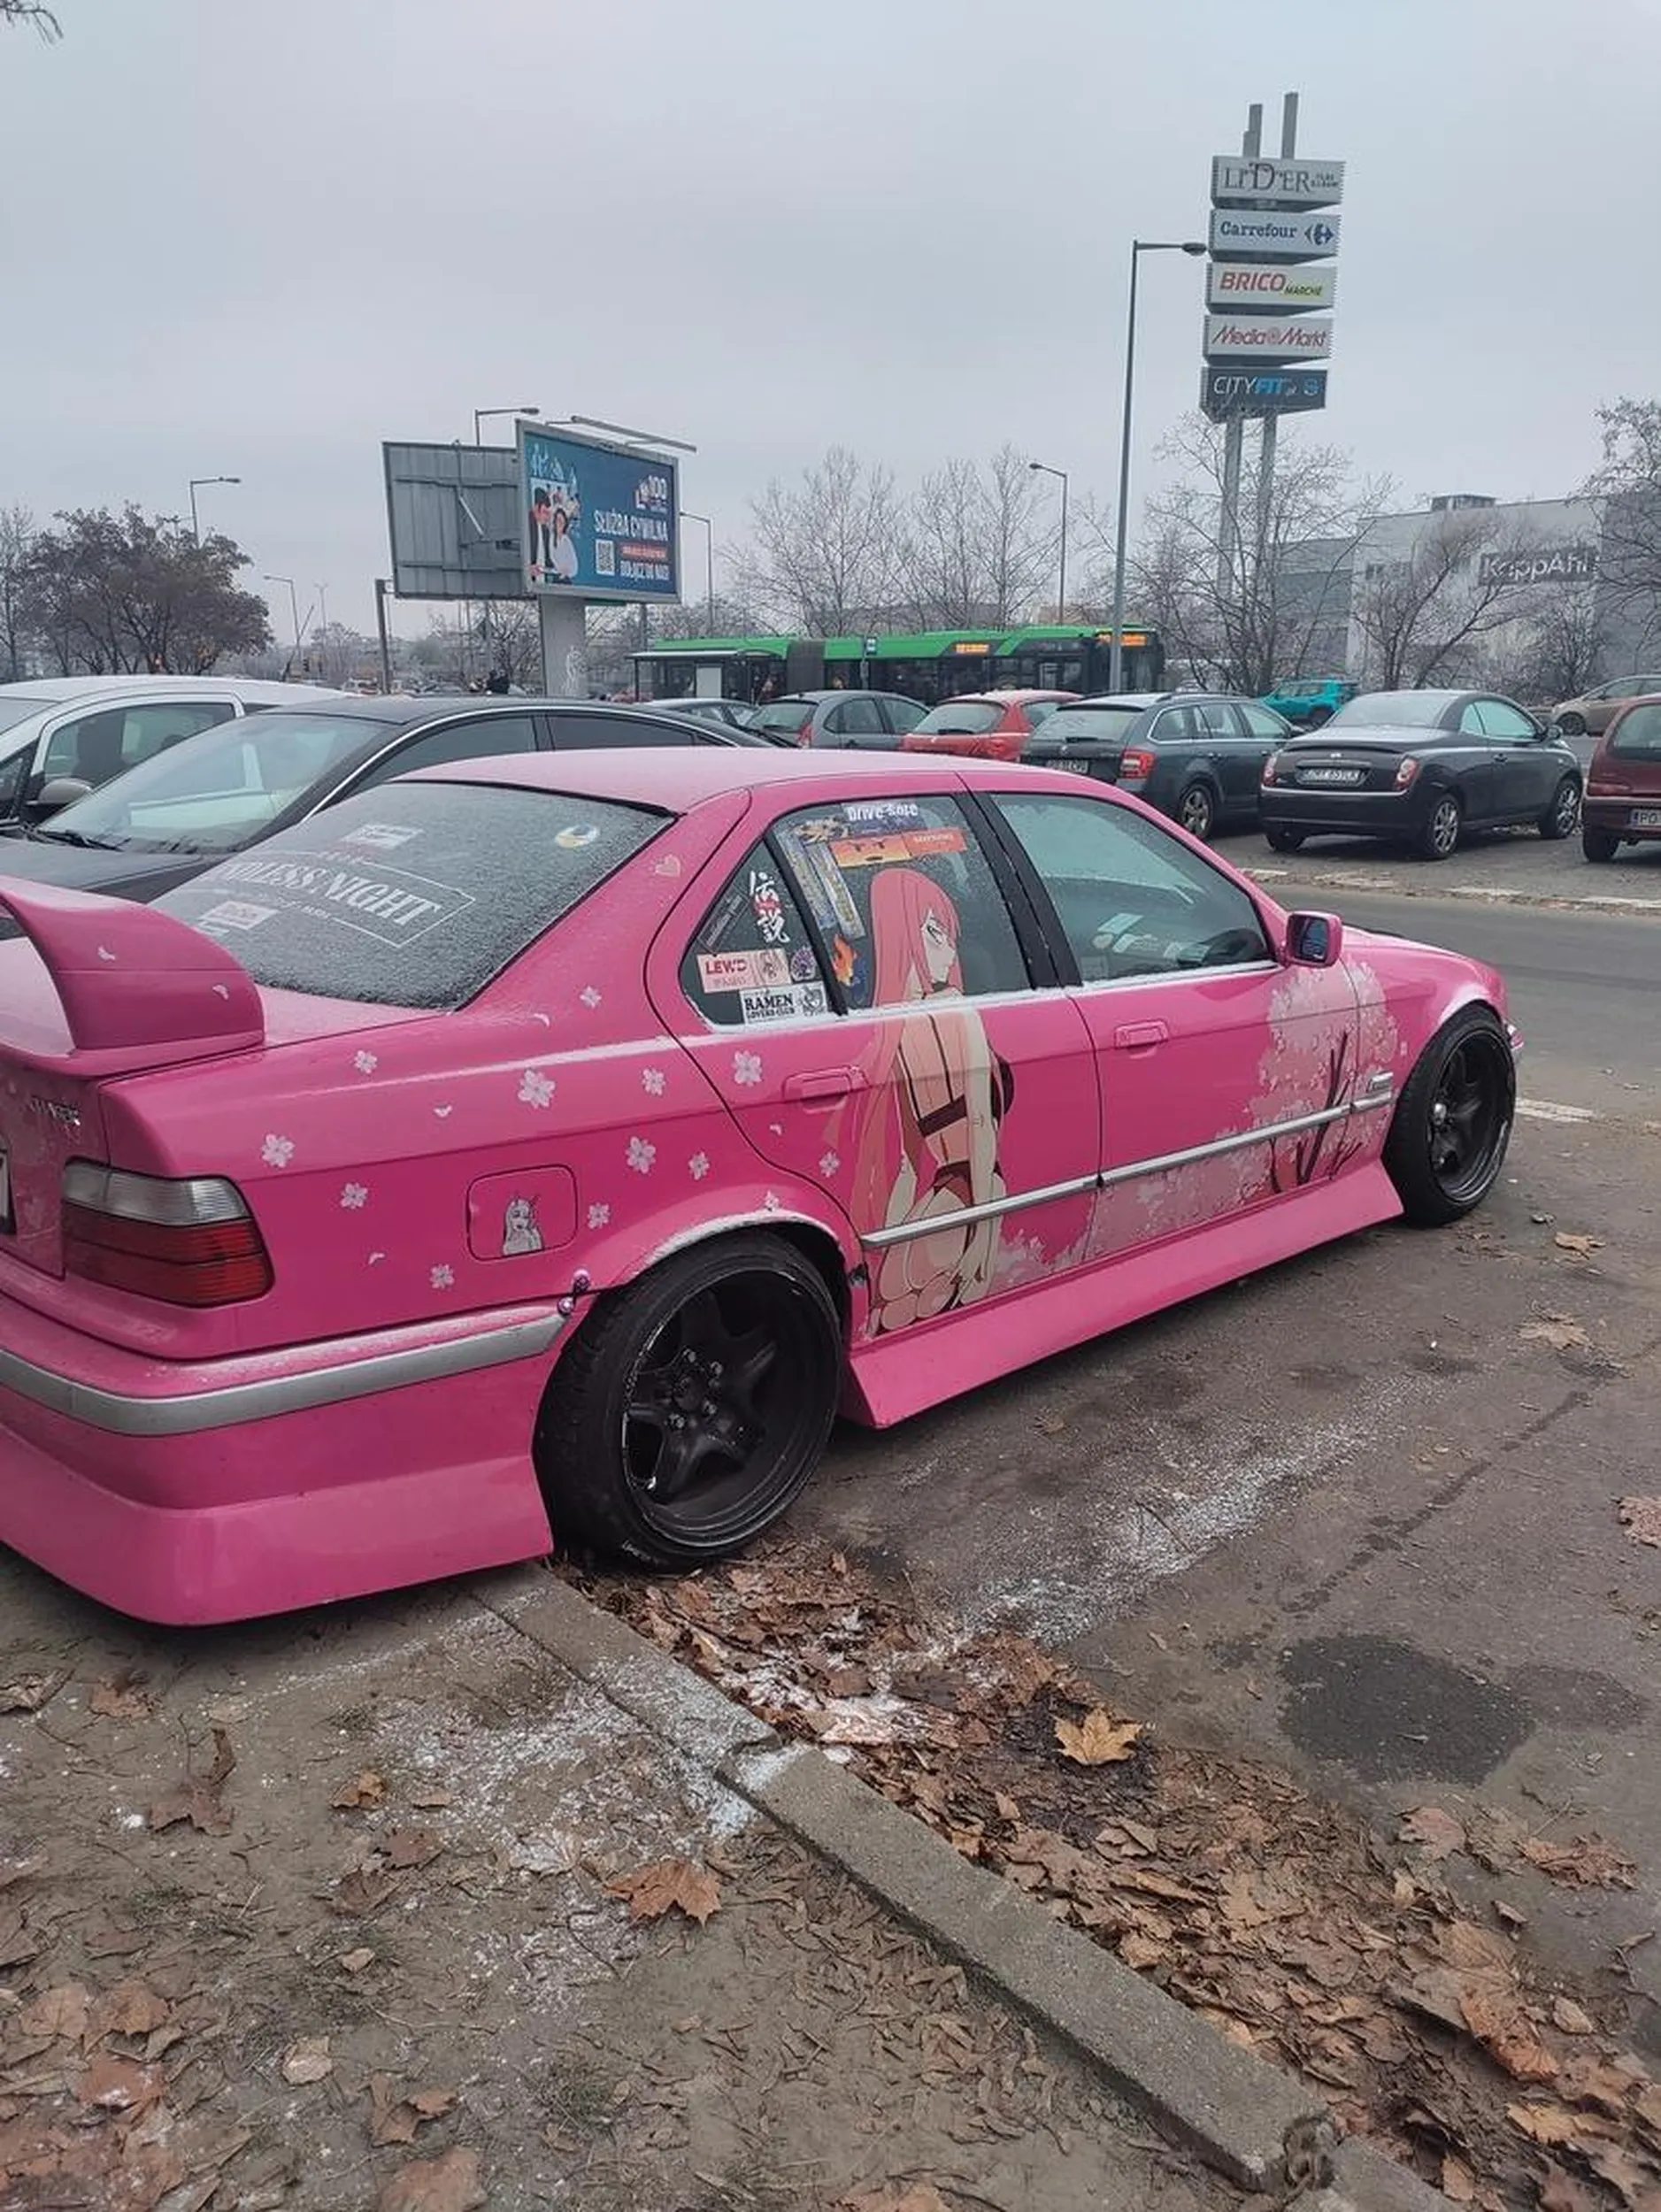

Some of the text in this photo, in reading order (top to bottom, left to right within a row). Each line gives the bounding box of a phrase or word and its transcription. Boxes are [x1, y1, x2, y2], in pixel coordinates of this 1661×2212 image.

[1220, 221, 1297, 238] Carrefour
[1220, 272, 1286, 291] BRICO
[311, 870, 442, 926] NIGHT
[705, 959, 748, 975] LEWD
[743, 993, 794, 1011] RAMEN
